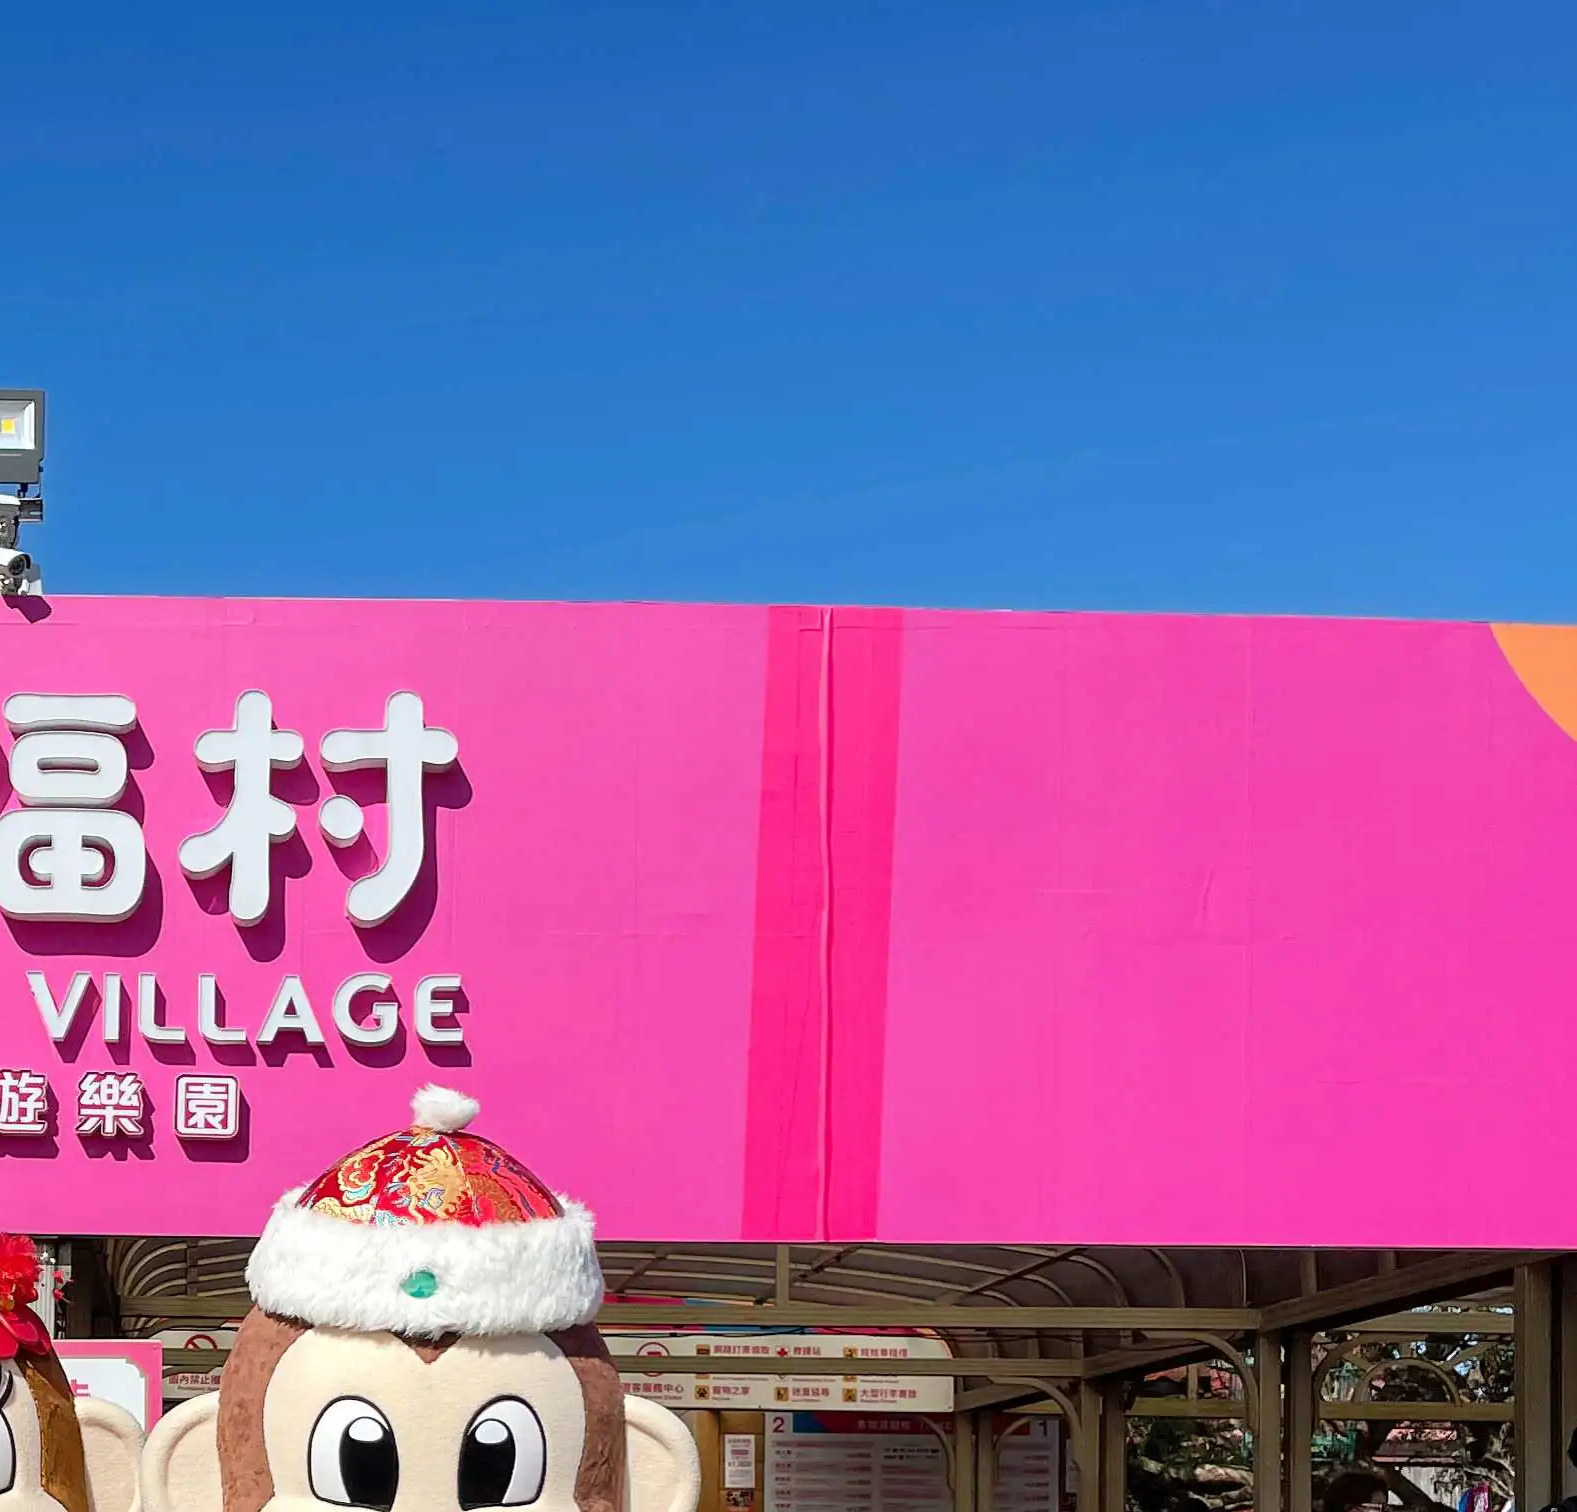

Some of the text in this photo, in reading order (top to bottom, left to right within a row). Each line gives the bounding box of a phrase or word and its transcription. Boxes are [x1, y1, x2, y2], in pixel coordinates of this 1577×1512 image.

[28, 973, 466, 1046] VILLAGE
[772, 1416, 786, 1433] 2
[1040, 1420, 1049, 1437] 1
